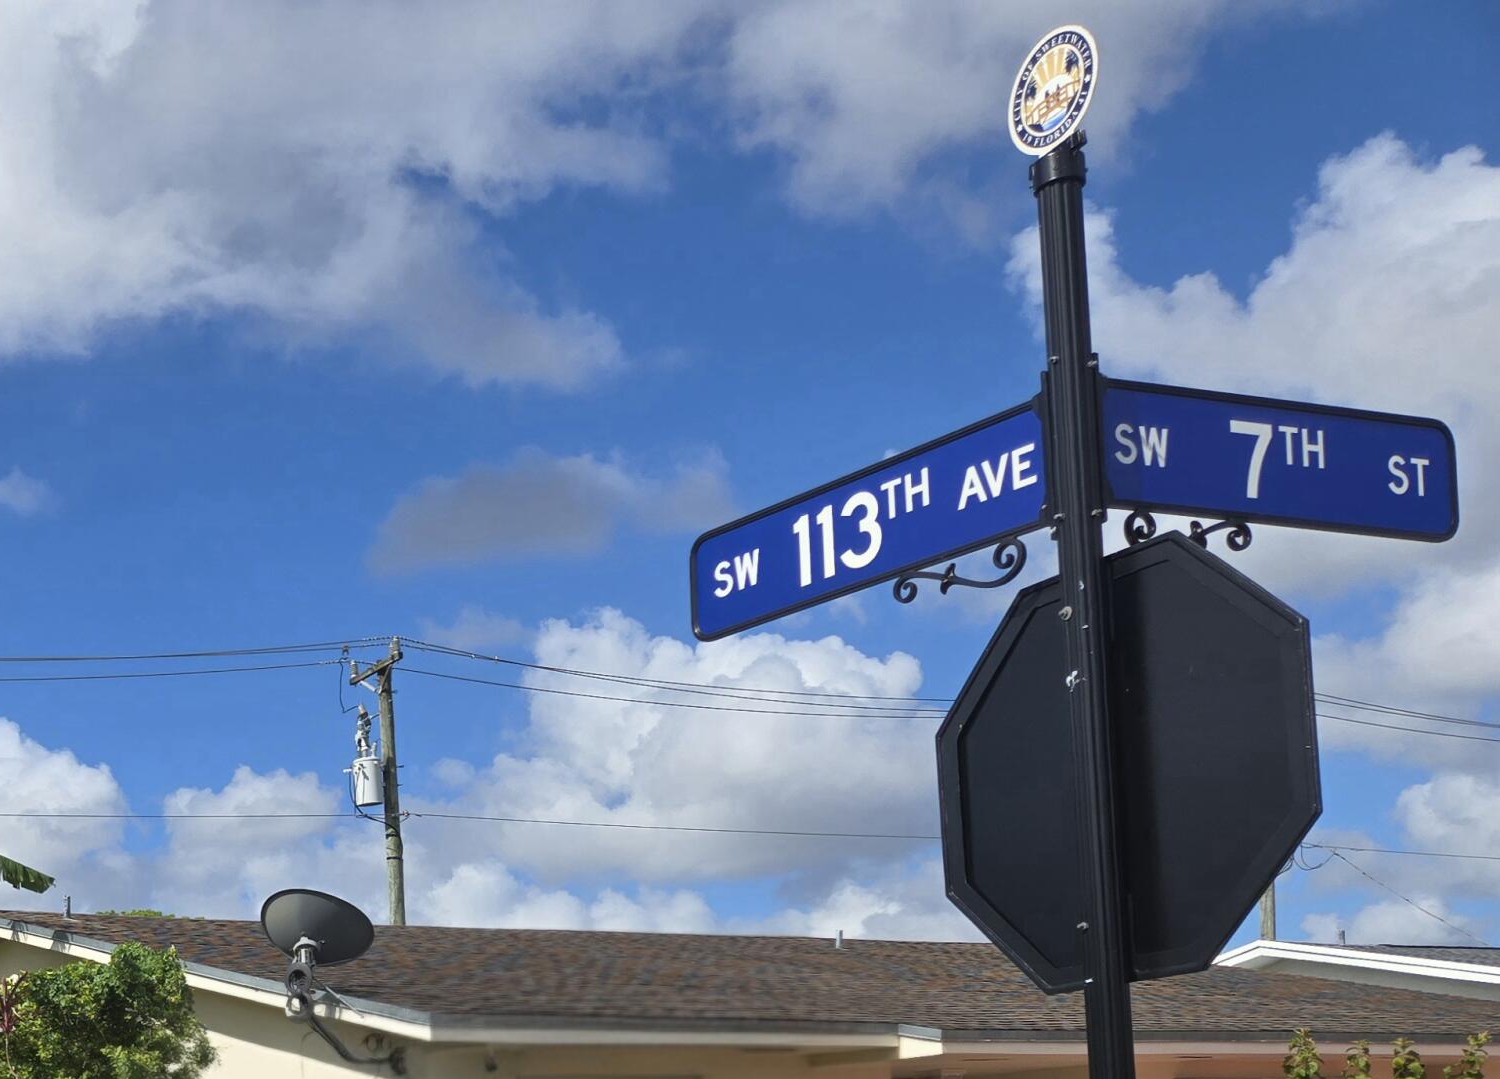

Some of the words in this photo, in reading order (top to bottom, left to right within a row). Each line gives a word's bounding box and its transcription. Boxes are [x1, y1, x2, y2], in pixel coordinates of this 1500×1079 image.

[1022, 65, 1034, 81] OF
[1035, 33, 1092, 68] SWEETWATER
[1034, 111, 1078, 146] FLORIDA
[1112, 423, 1169, 468] SW
[1229, 419, 1325, 499] 7TH
[1387, 455, 1431, 497] ST
[712, 547, 761, 599] SW
[791, 466, 931, 588] 113TH
[956, 442, 1038, 512] AVE
